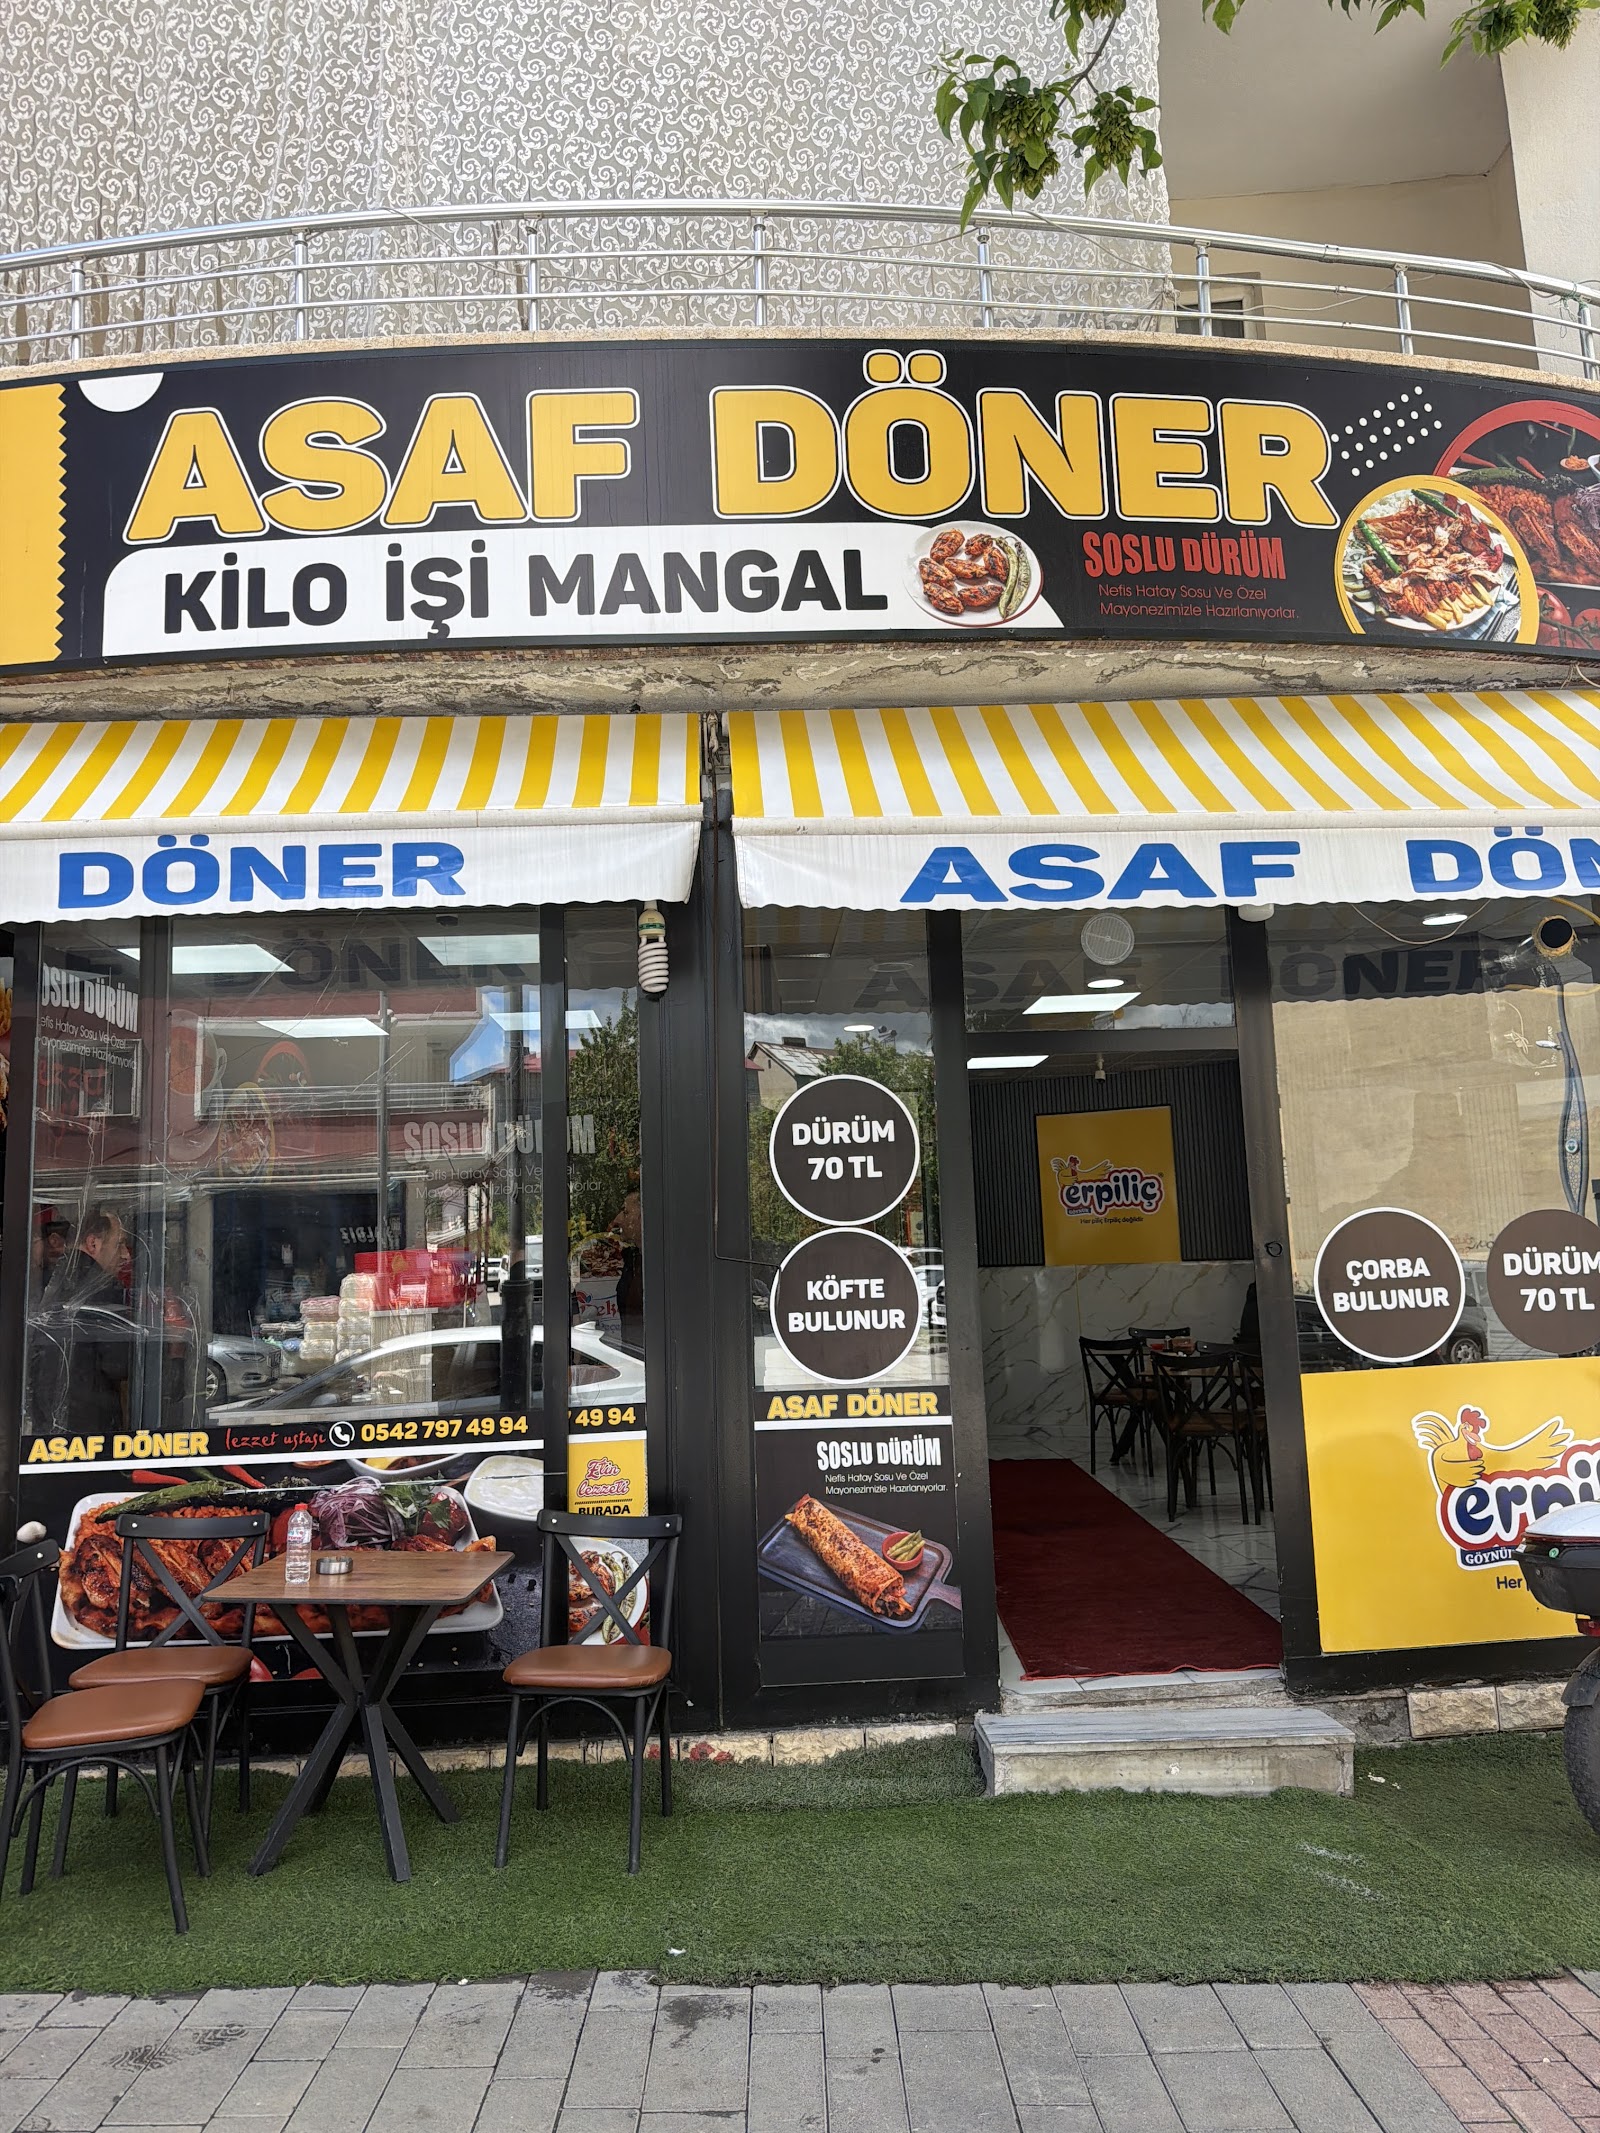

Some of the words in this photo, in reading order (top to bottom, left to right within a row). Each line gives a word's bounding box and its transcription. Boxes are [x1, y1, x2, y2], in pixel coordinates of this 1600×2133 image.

[123, 389, 640, 544] ASAF
[709, 349, 1339, 529] DÖNER
[1082, 531, 1177, 578] SOSLU
[1181, 529, 1287, 580] DÜRÜM
[164, 552, 347, 635] KİLO
[386, 539, 489, 640] İŞİ
[529, 547, 888, 616] MANGAL
[1098, 584, 1133, 598] Nefis
[1136, 584, 1177, 600] Hatay
[1181, 585, 1212, 599] Sosu
[1214, 586, 1233, 599] Ve
[1237, 585, 1267, 600] Özel
[1100, 602, 1202, 618] Mayonezimizle
[58, 834, 466, 909] DÖNER
[899, 841, 1302, 904] ASAF
[84, 976, 139, 1034] DÜRÜM
[55, 1017, 79, 1038] Hatay
[79, 1025, 98, 1041] Sosu
[792, 1114, 895, 1146] DÜRÜM
[451, 1167, 490, 1181] Hatay
[493, 1166, 522, 1179] Sosu
[807, 1156, 844, 1181] 70
[848, 1155, 882, 1179] TL
[1065, 1174, 1158, 1210] erpiliç
[1345, 1257, 1431, 1286] ÇORBA
[806, 1274, 885, 1301] KÖFTE
[1333, 1286, 1450, 1313] BULUNUR
[1520, 1287, 1557, 1312] 70
[1559, 1287, 1596, 1311] TL
[788, 1308, 906, 1332] BULUNUR
[575, 1408, 604, 1427] 49
[607, 1406, 637, 1426] 94
[766, 1394, 839, 1420] ASAF
[846, 1387, 939, 1417] DÖNER
[225, 1427, 279, 1450] lezzet
[361, 1421, 418, 1443] 0542
[422, 1419, 463, 1440] 797
[465, 1417, 495, 1437] 49
[499, 1415, 529, 1435] 94
[27, 1435, 105, 1463] ASAF
[112, 1430, 210, 1459] DÖNER
[816, 1440, 873, 1471] SOSLU
[876, 1433, 942, 1466] DÜRÜM
[576, 1478, 631, 1498] lezzeti
[825, 1473, 846, 1483] Nefis
[847, 1473, 873, 1484] Hatay
[874, 1472, 894, 1482] Sosu
[895, 1472, 907, 1481] Ve
[909, 1470, 929, 1480] Özel
[825, 1484, 888, 1496] Mayonezimizle
[1496, 1576, 1523, 1590] Her
